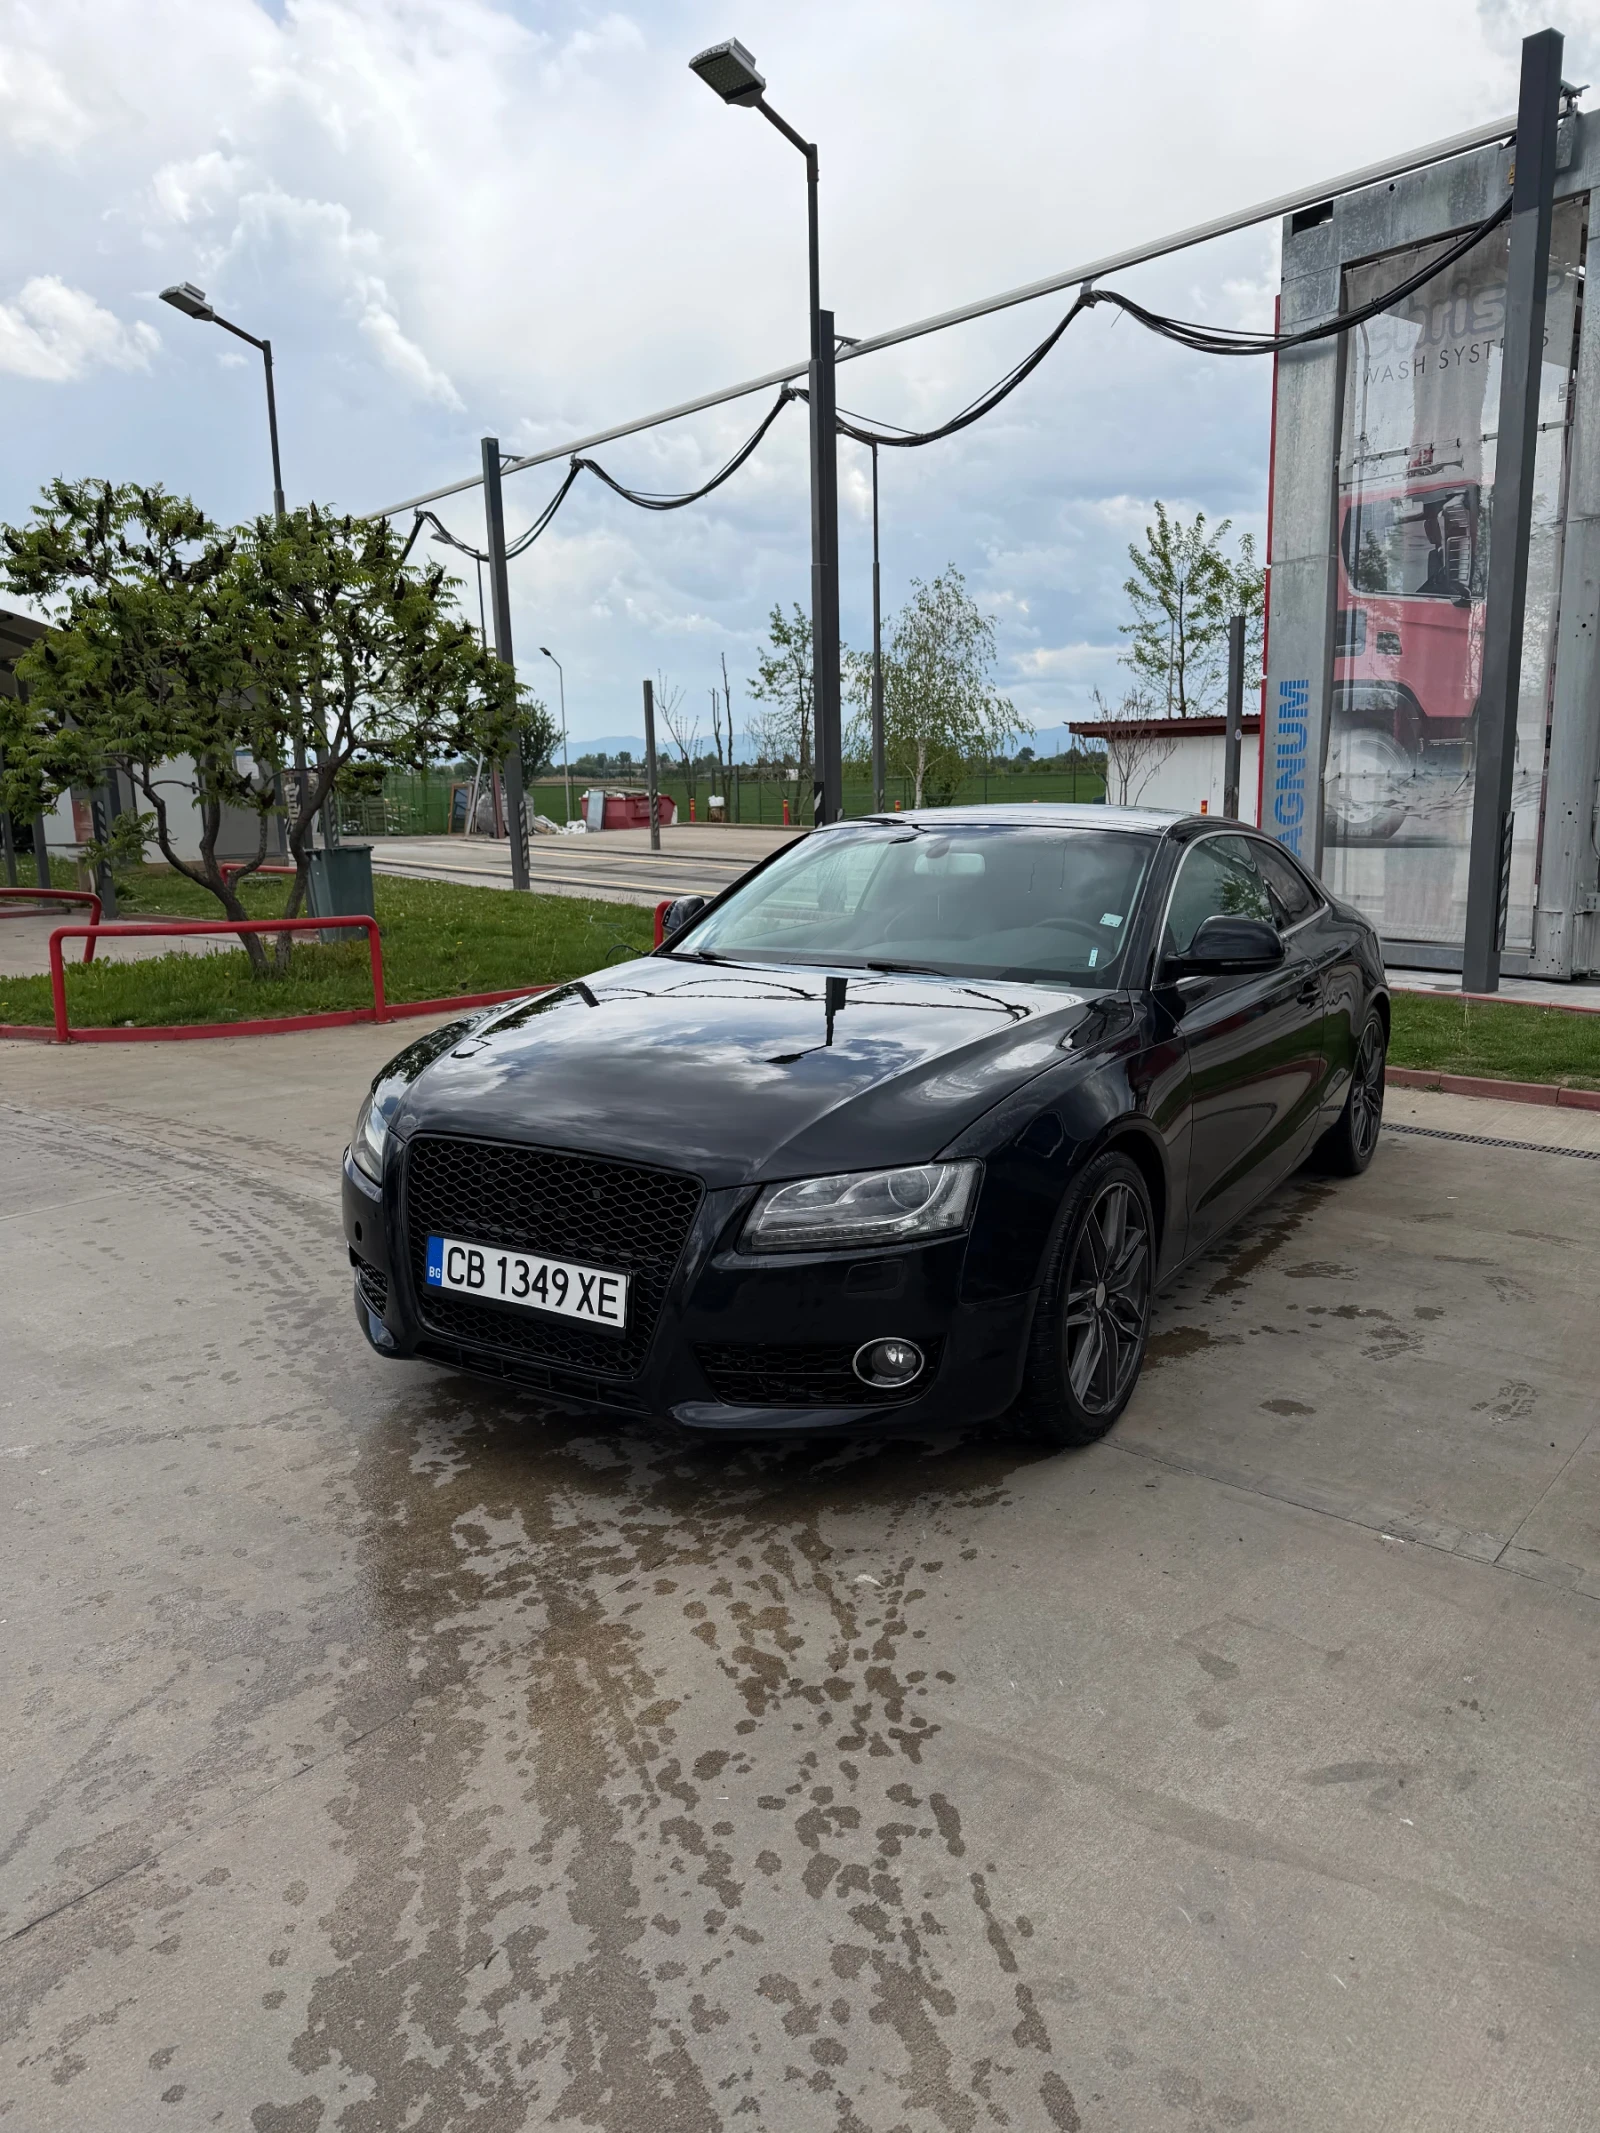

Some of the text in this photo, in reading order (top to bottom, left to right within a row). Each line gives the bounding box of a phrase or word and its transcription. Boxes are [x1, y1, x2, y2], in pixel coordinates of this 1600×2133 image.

[1363, 355, 1426, 385] WASH
[428, 1246, 619, 1320] BG CB 1349 XE
